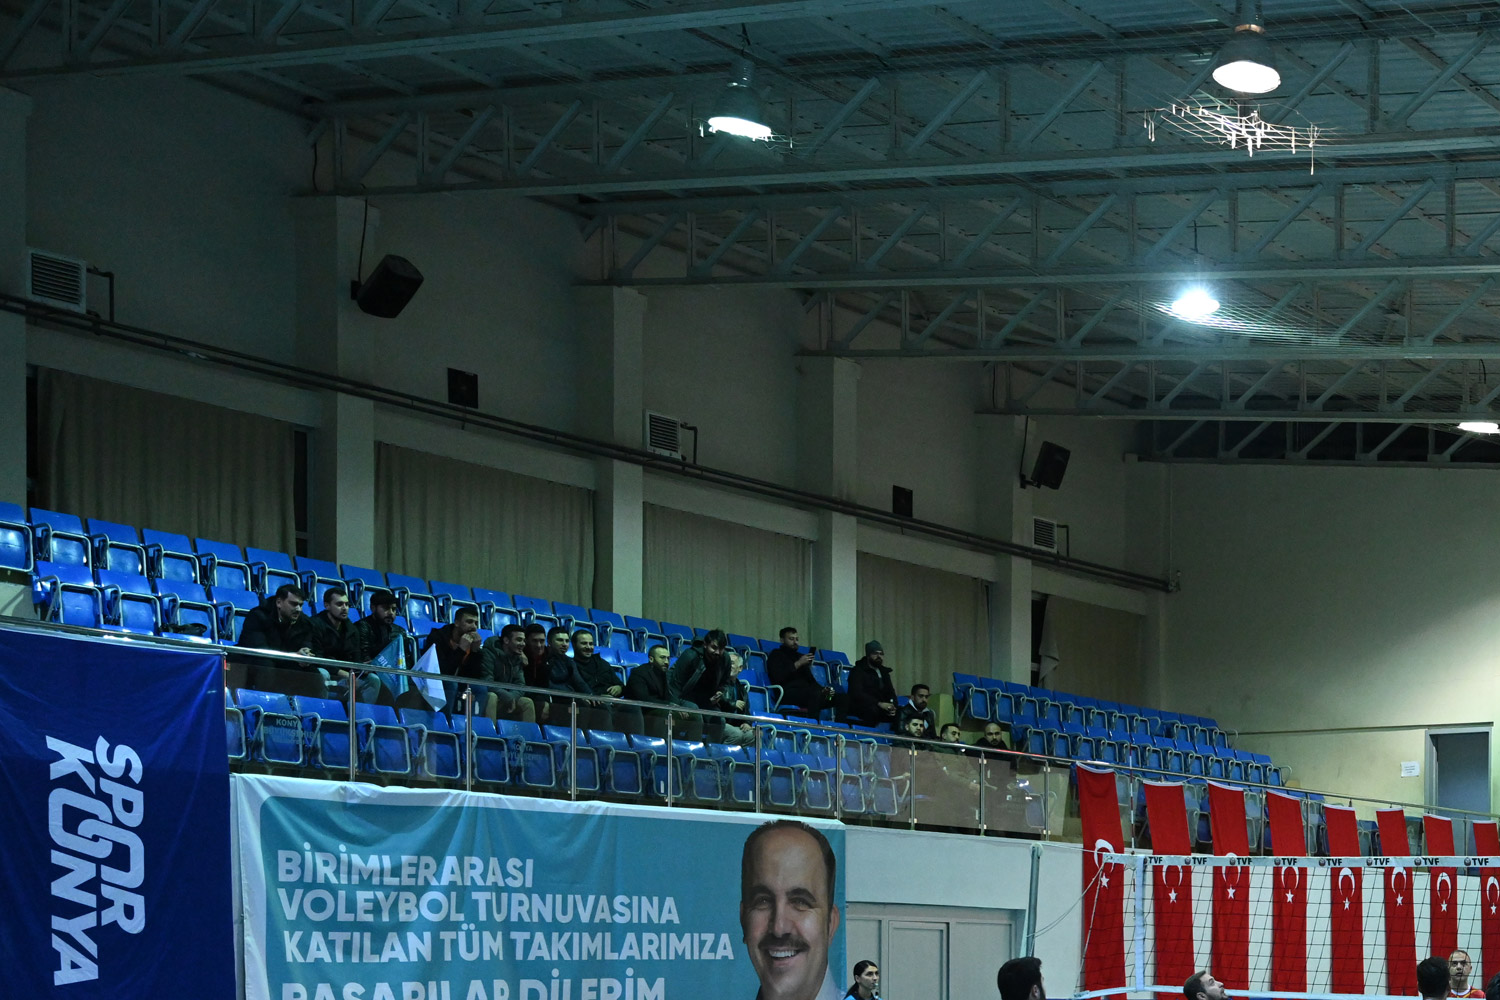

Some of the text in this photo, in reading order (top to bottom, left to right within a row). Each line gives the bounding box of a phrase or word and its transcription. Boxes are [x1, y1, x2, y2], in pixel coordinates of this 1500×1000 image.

[78, 735, 145, 934] SPOR
[46, 735, 113, 986] KONYA
[277, 842, 534, 888] BİRİMLERARASI
[1149, 857, 1163, 865] TVF
[1192, 857, 1207, 865] TVF
[1236, 858, 1252, 866] TVF
[1281, 858, 1297, 866] TVF
[1327, 858, 1343, 866] TVF
[1374, 858, 1390, 866] TVF
[1423, 857, 1440, 866] TVF
[1472, 857, 1489, 866] TVF
[277, 888, 680, 924] VOLEYBOL TURNUVASINA
[283, 923, 735, 963] KATILAN TÜM TAKIMLARIMIZA
